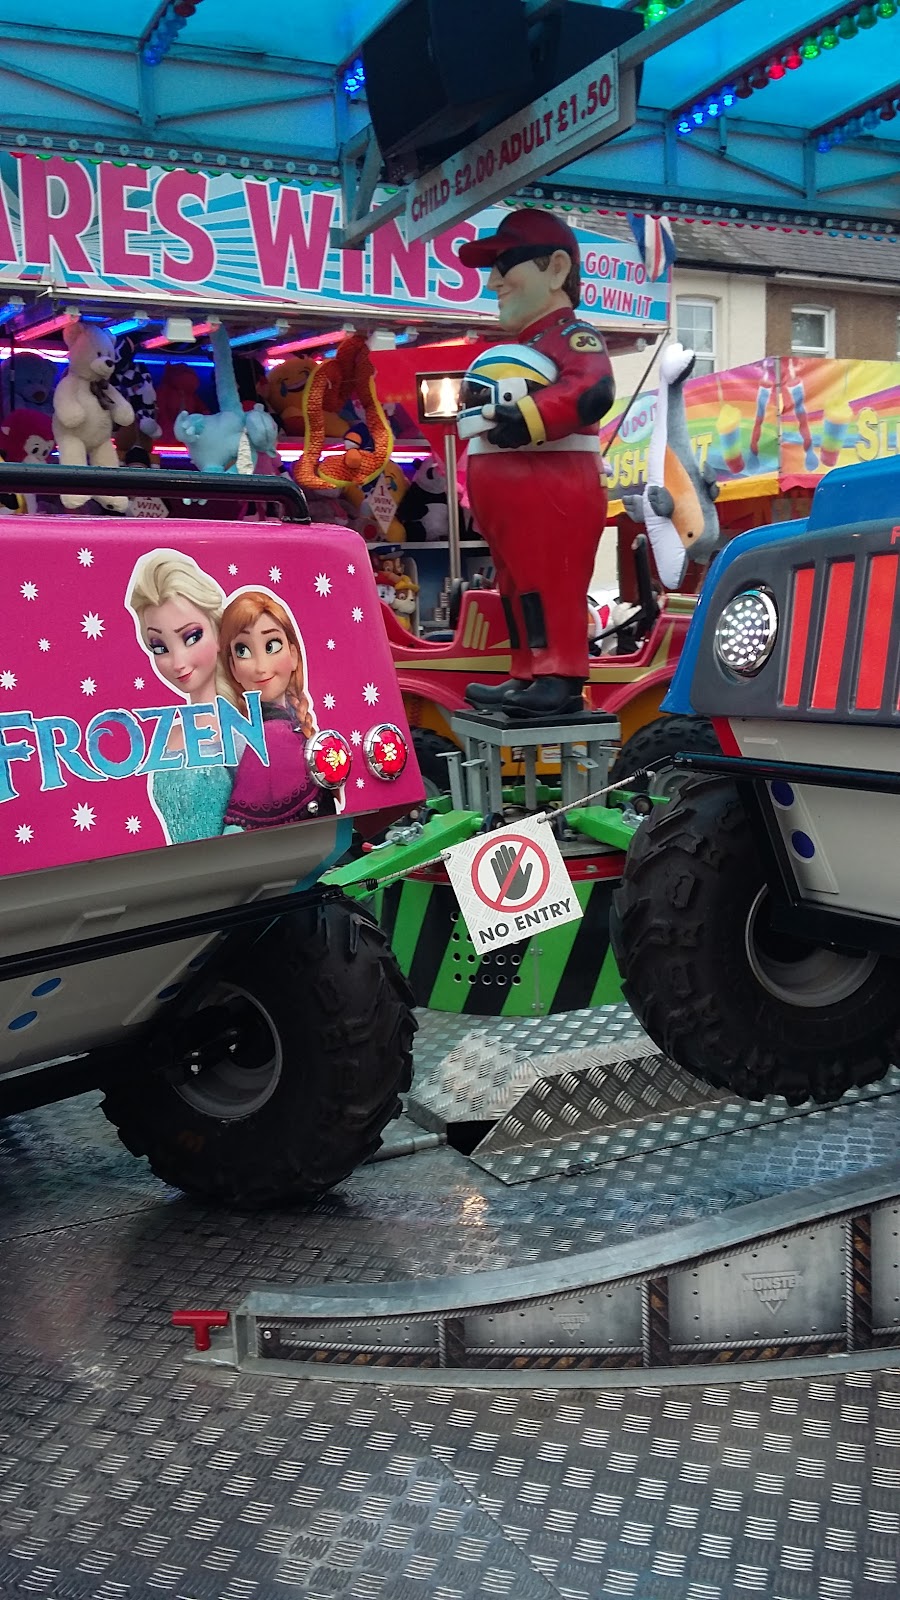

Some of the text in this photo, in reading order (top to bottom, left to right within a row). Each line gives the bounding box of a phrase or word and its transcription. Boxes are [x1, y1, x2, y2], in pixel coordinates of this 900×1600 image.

[411, 73, 612, 222] CHILD £2.00 ADULT £1.50
[585, 251, 647, 285] GOT TO
[602, 287, 633, 313] WIN
[636, 295, 653, 317] IT
[621, 424, 630, 438] U
[632, 410, 648, 433] DO
[137, 501, 162, 511] WIN
[0, 690, 270, 804] FROZEN
[478, 897, 572, 945] NO ENTRY
